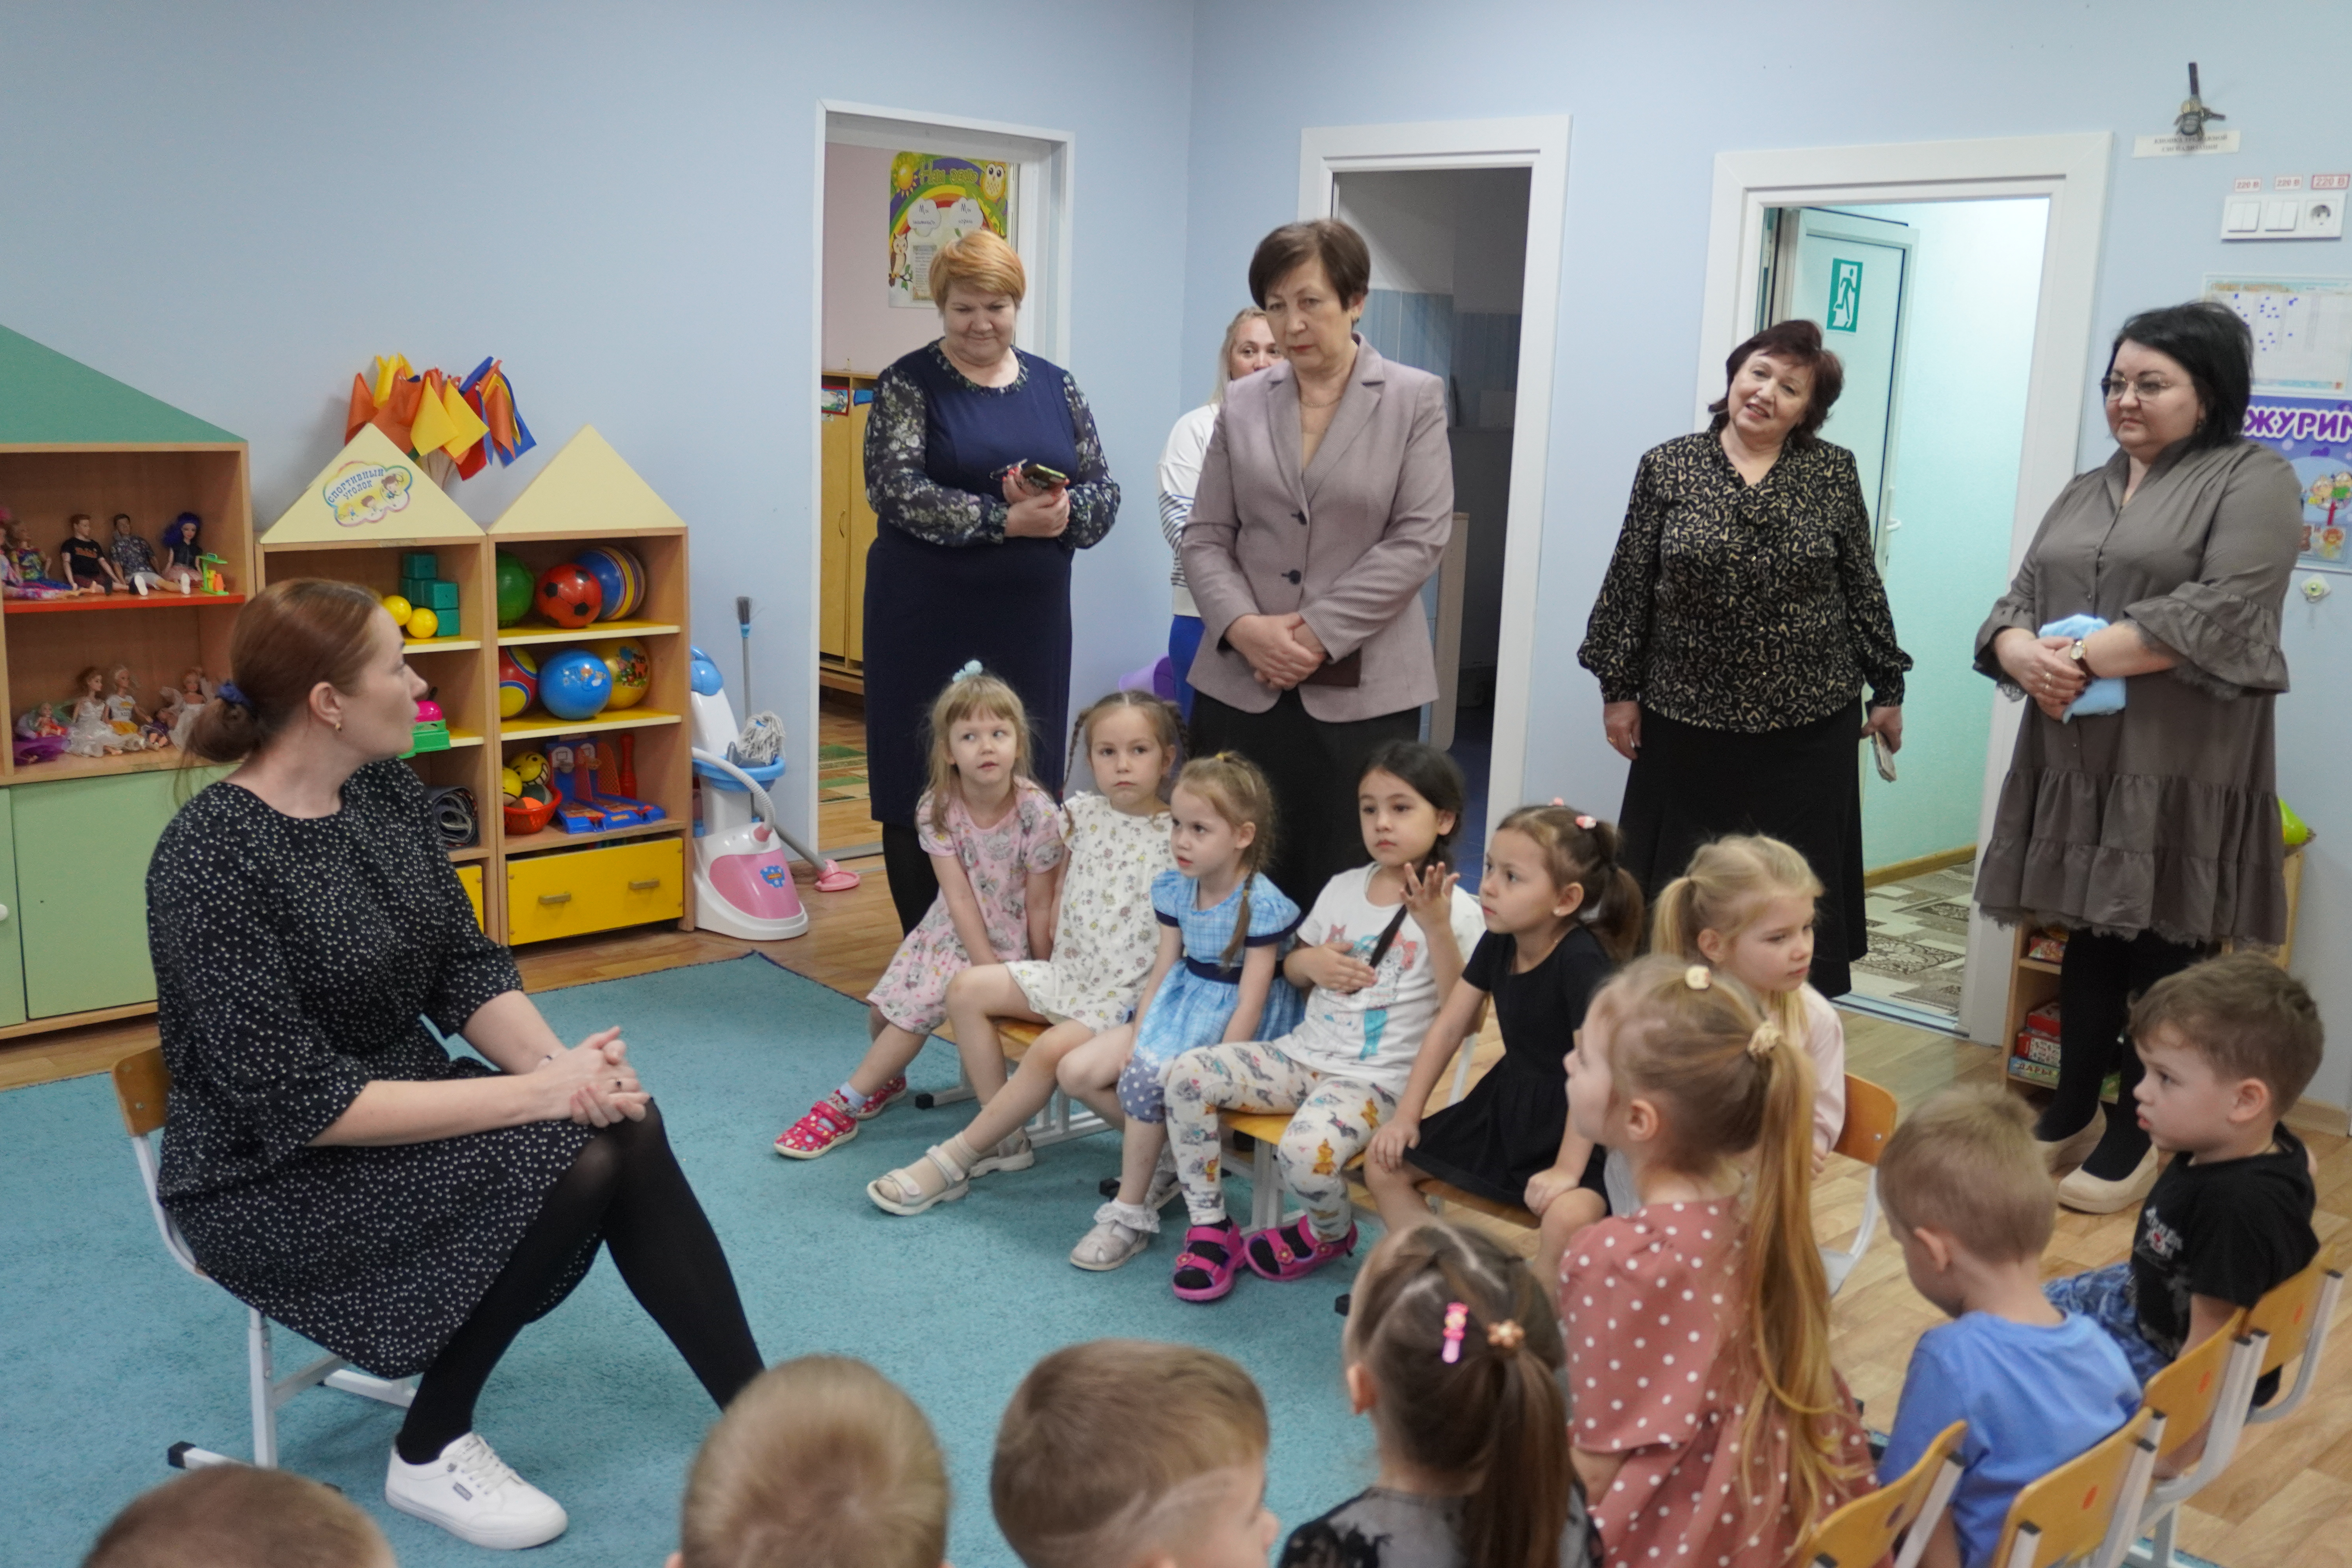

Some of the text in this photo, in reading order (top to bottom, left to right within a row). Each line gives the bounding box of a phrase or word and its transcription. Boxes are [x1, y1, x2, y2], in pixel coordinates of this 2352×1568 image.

[2277, 179, 2291, 187] 220
[2315, 176, 2334, 187] 220
[328, 468, 384, 503] СПОРТИВНЫЙ
[343, 480, 373, 499] УГОЛОК
